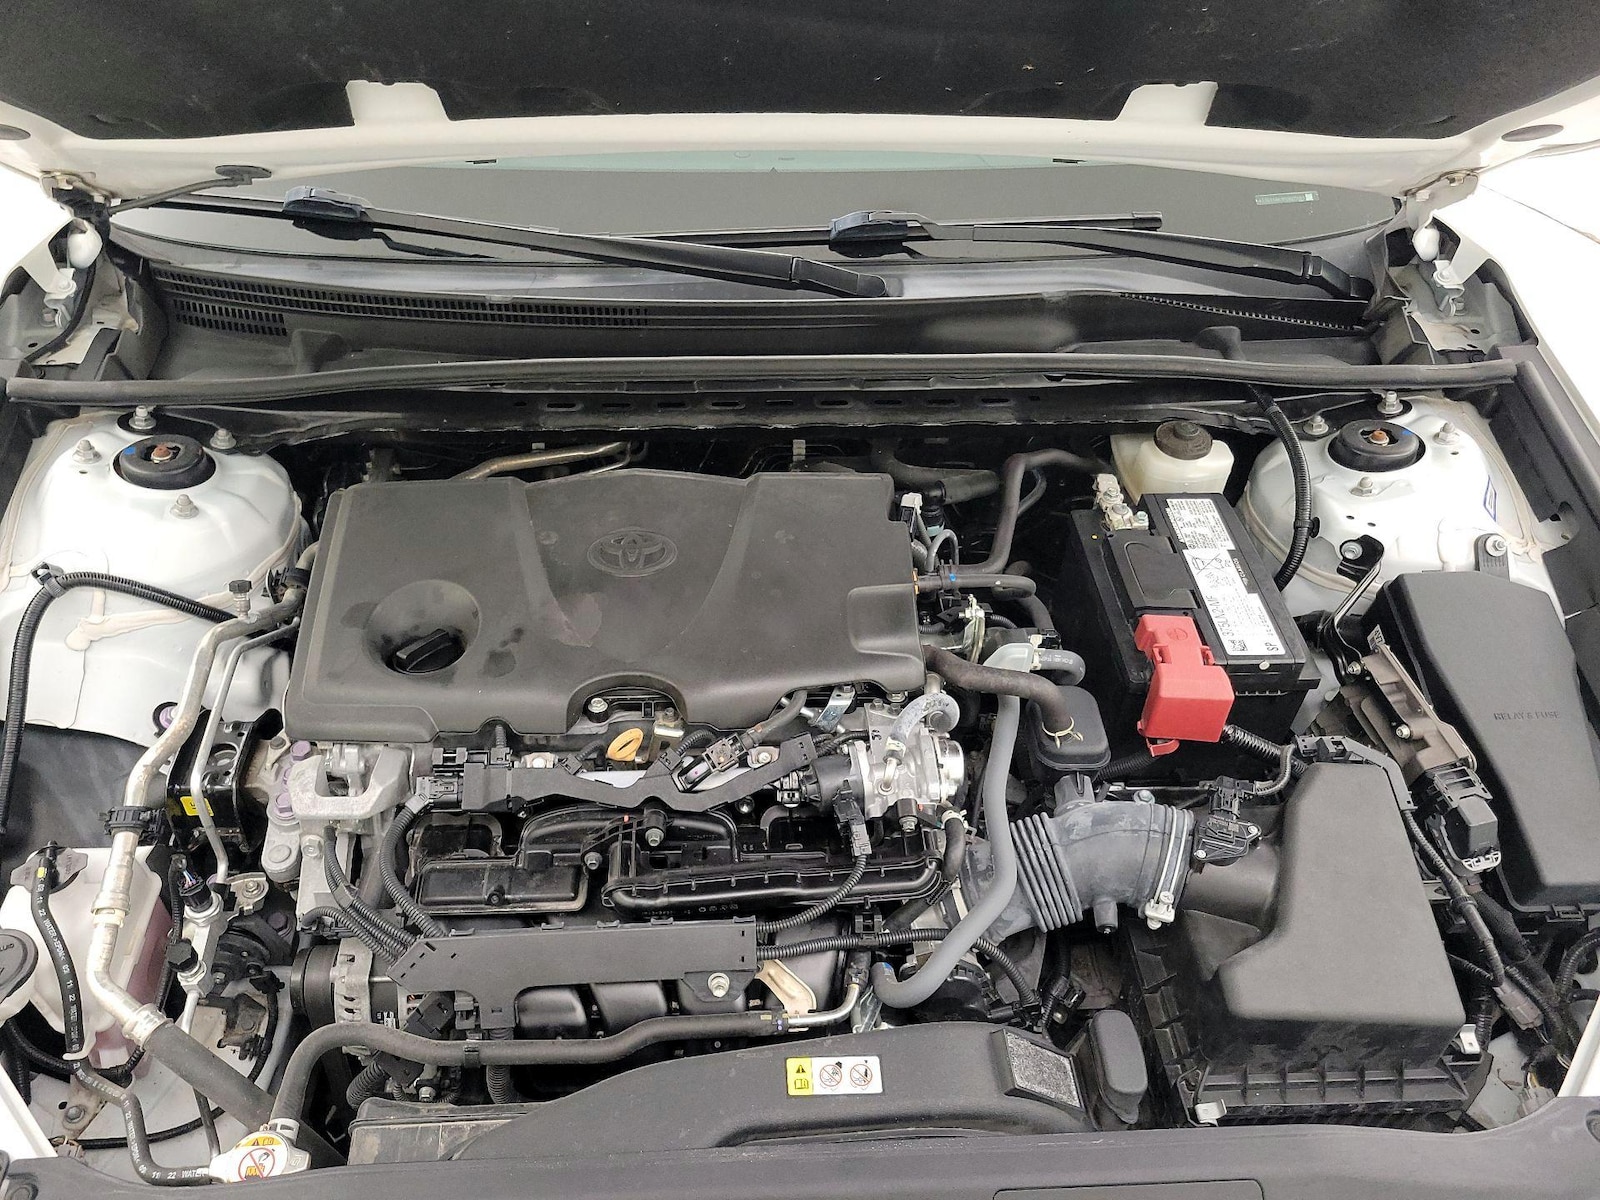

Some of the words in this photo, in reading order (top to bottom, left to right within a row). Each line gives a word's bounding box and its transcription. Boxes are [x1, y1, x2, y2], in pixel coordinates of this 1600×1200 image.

[1493, 711, 1525, 720] RELAY
[1535, 710, 1560, 719] FUSE
[167, 1171, 177, 1179] 22
